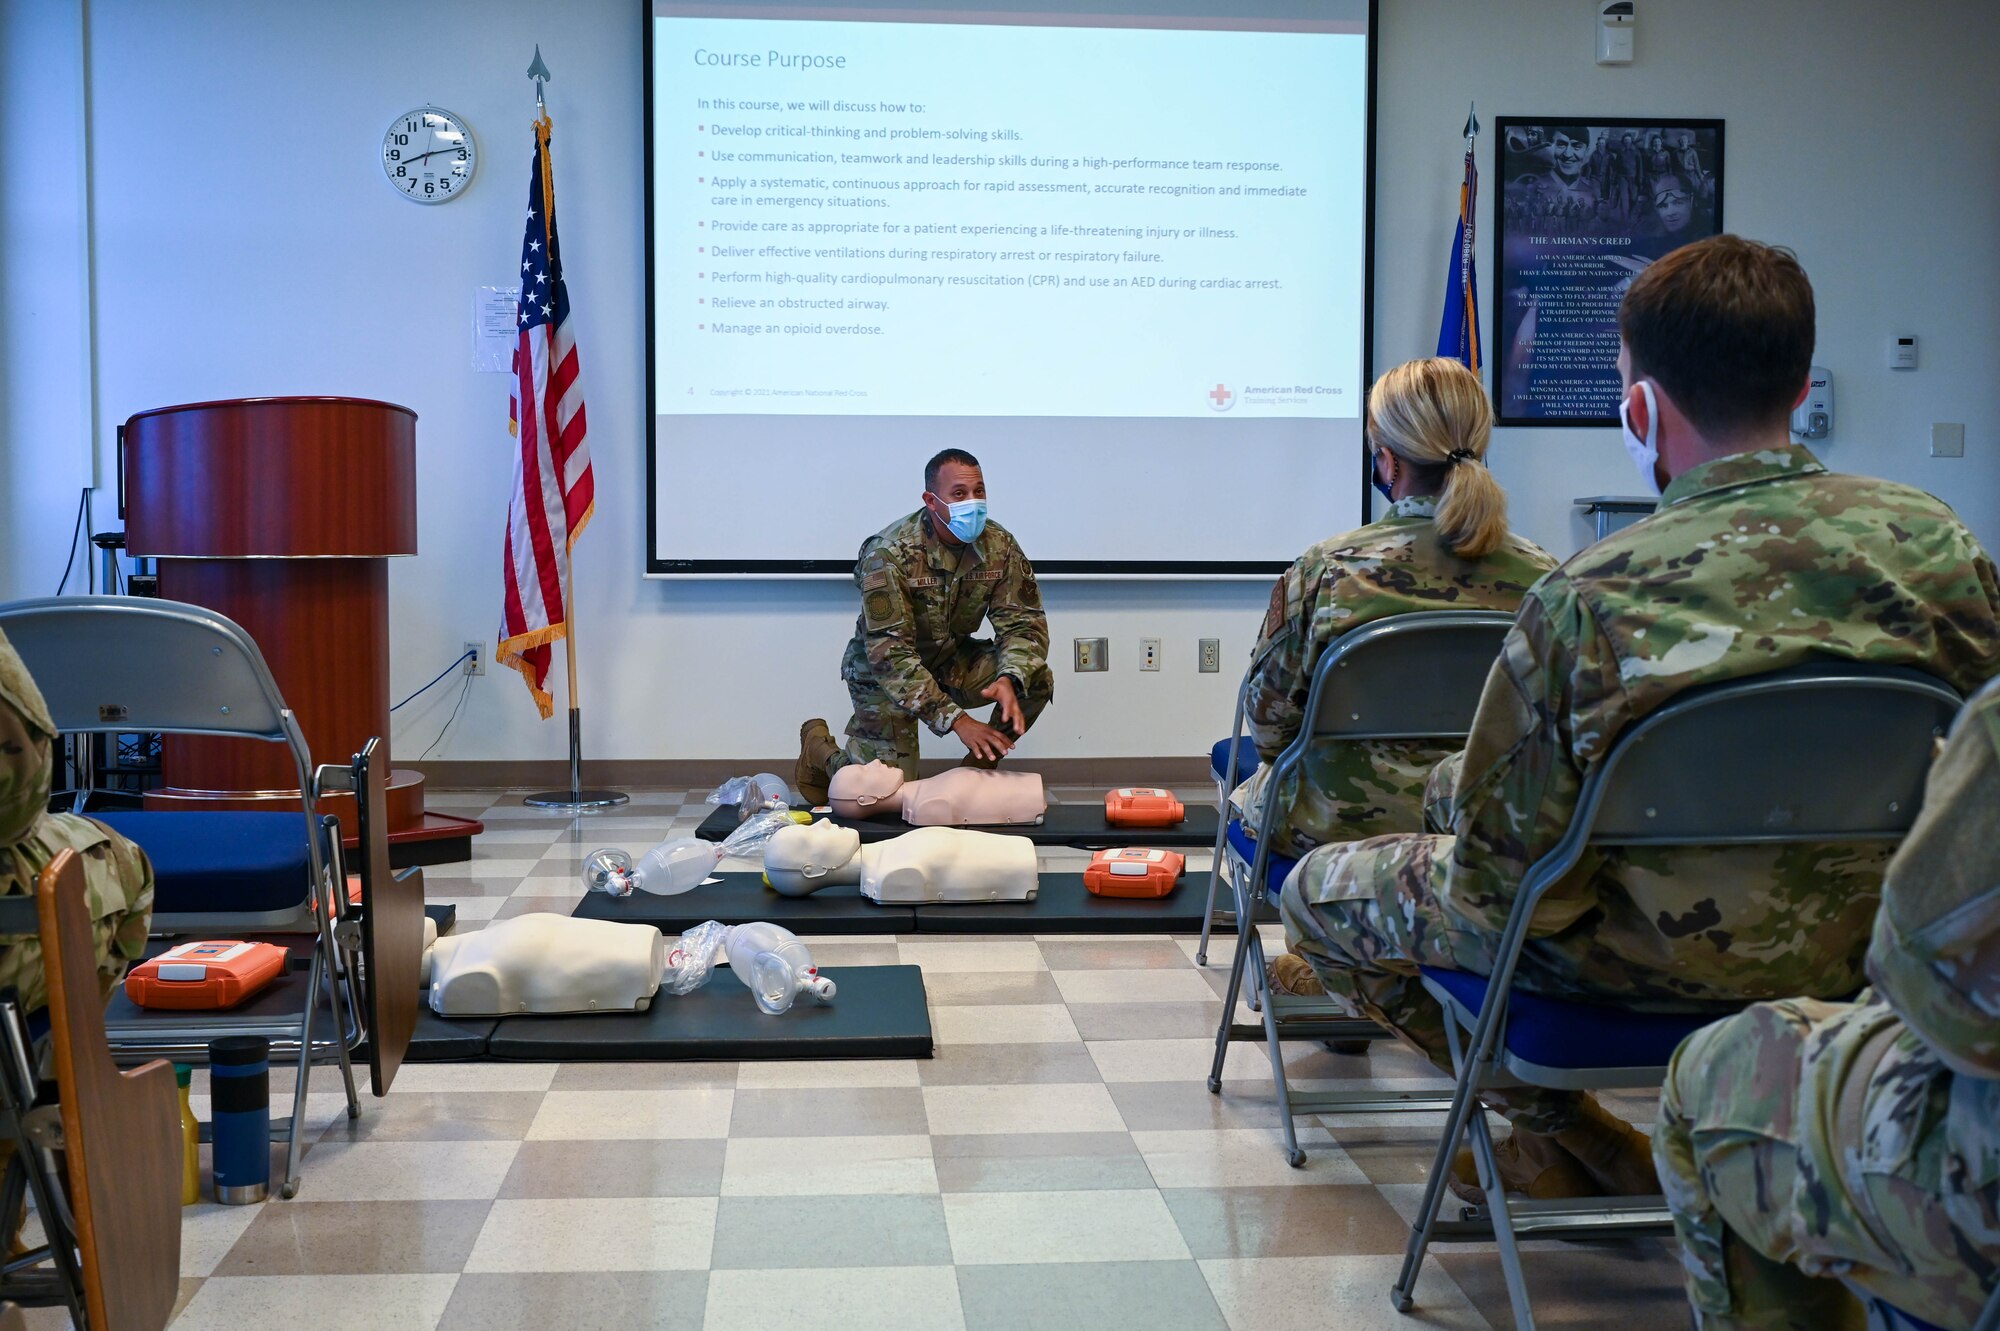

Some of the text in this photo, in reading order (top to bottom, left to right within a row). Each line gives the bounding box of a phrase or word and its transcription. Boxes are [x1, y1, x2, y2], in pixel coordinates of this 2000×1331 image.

[694, 48, 846, 72] Course Purpose
[697, 97, 926, 113] In this course, we will discuss how to:
[408, 122, 417, 132] 11
[422, 117, 435, 127] 12
[444, 122, 447, 132] 1
[711, 123, 1023, 143] Develop critical-thinking and problem-solving skills.
[395, 134, 408, 145] 10
[390, 150, 400, 160] 9
[458, 150, 467, 161] 3
[711, 150, 1283, 173] Use communication, teamwork and leadership skills during a high-performance team response.
[396, 166, 406, 177] 8
[408, 178, 417, 188] 7
[424, 182, 434, 194] 6
[440, 178, 449, 189] 5
[710, 175, 1307, 197] Apply a systematic, continuous approach for rapid assessment, accurate recognition and immediate
[710, 194, 890, 209] care in emergency situations.
[711, 219, 1239, 240] Provide care as appropriate for a patient experiencing a life-threatening injury or illness.
[1530, 236, 1631, 245] THE AIRMAN'S CREED
[711, 245, 1164, 264] Deliver effective ventilations during respiratory arrest or respiratory failure.
[711, 271, 1283, 291] Perform high-quality cardiopulmonary resuscitation (CPR) and use an AED during cardiac arrest.
[711, 296, 890, 312] Relieve an obstructed airway.
[711, 322, 884, 336] Manage an opioid overdose.
[687, 386, 694, 396] 4
[1244, 385, 1343, 395] American Red Cross
[1243, 395, 1308, 405] Training Services
[985, 571, 1001, 579] FORCE
[917, 577, 938, 586] MILLER
